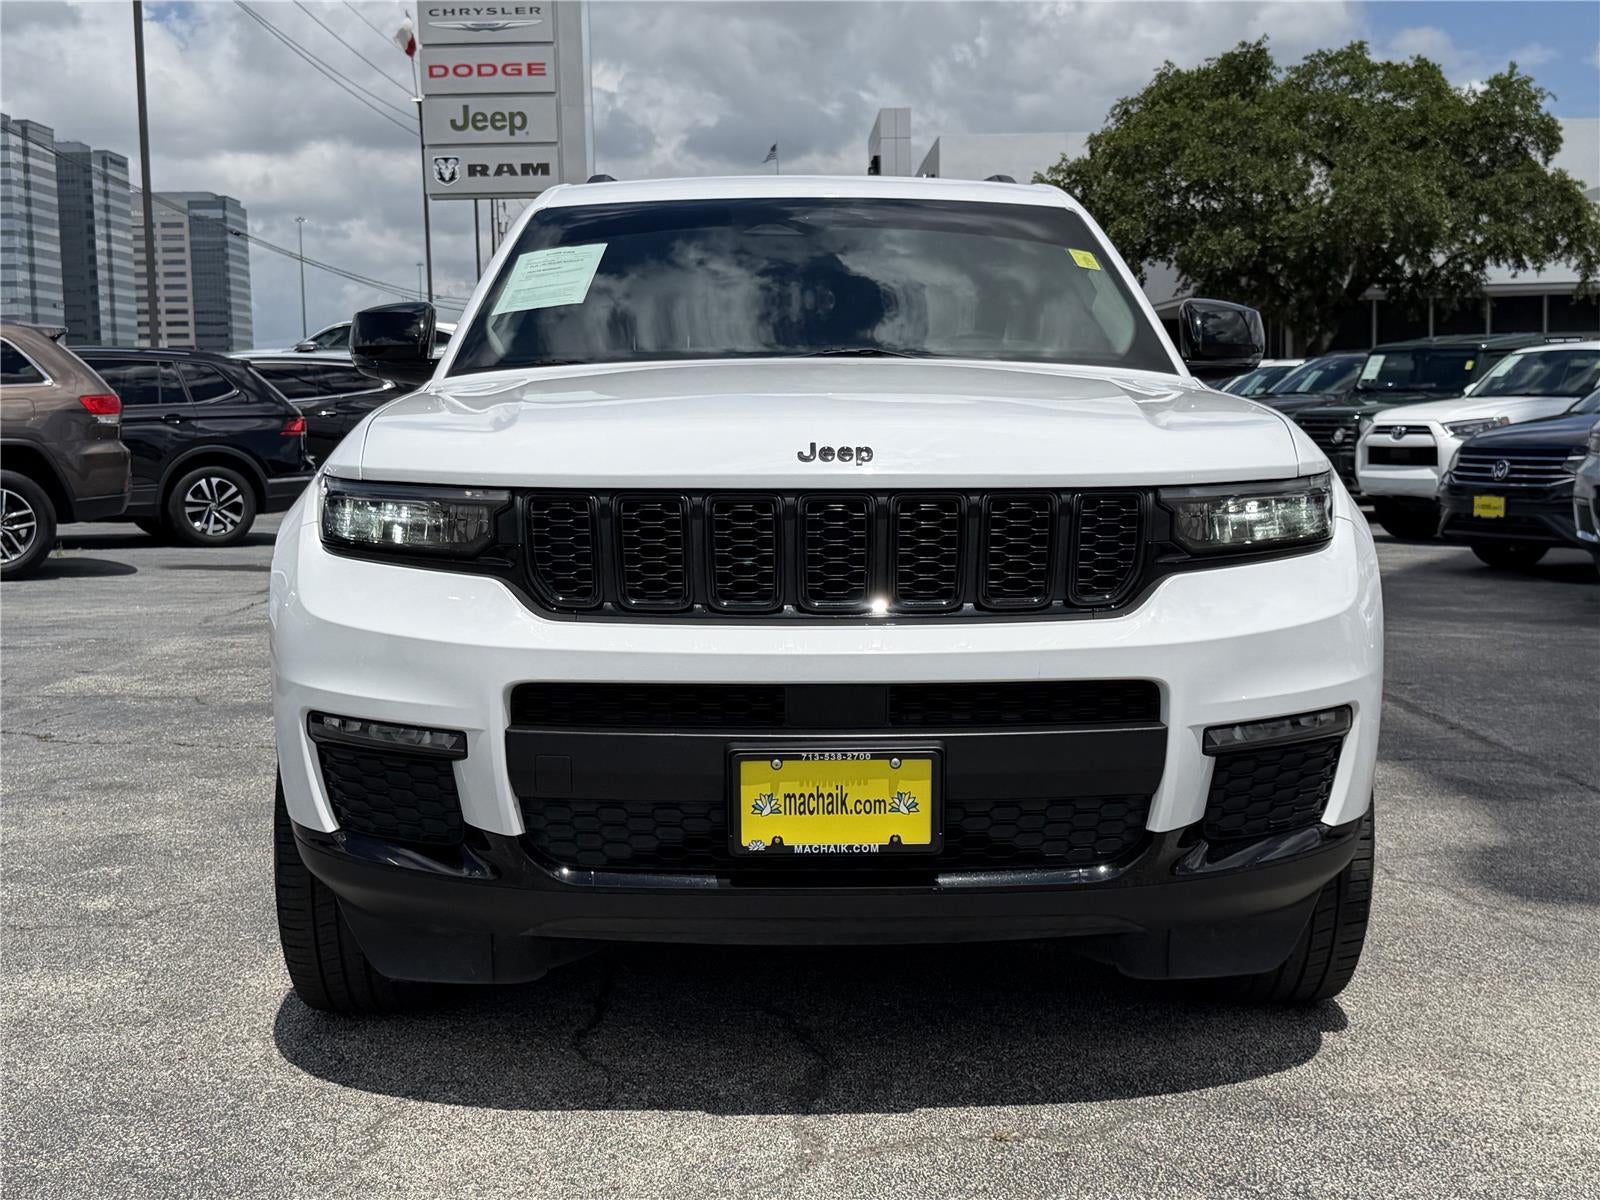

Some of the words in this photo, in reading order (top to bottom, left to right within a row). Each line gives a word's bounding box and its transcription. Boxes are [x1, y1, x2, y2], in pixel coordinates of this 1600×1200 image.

[428, 6, 542, 17] CHRYSLER
[428, 62, 547, 79] DODGE
[450, 104, 528, 136] Jeep
[467, 162, 550, 178] RAM
[797, 442, 874, 466] Jeep
[783, 785, 888, 816] machaik.com
[793, 844, 880, 854] MACHAIK.COM
